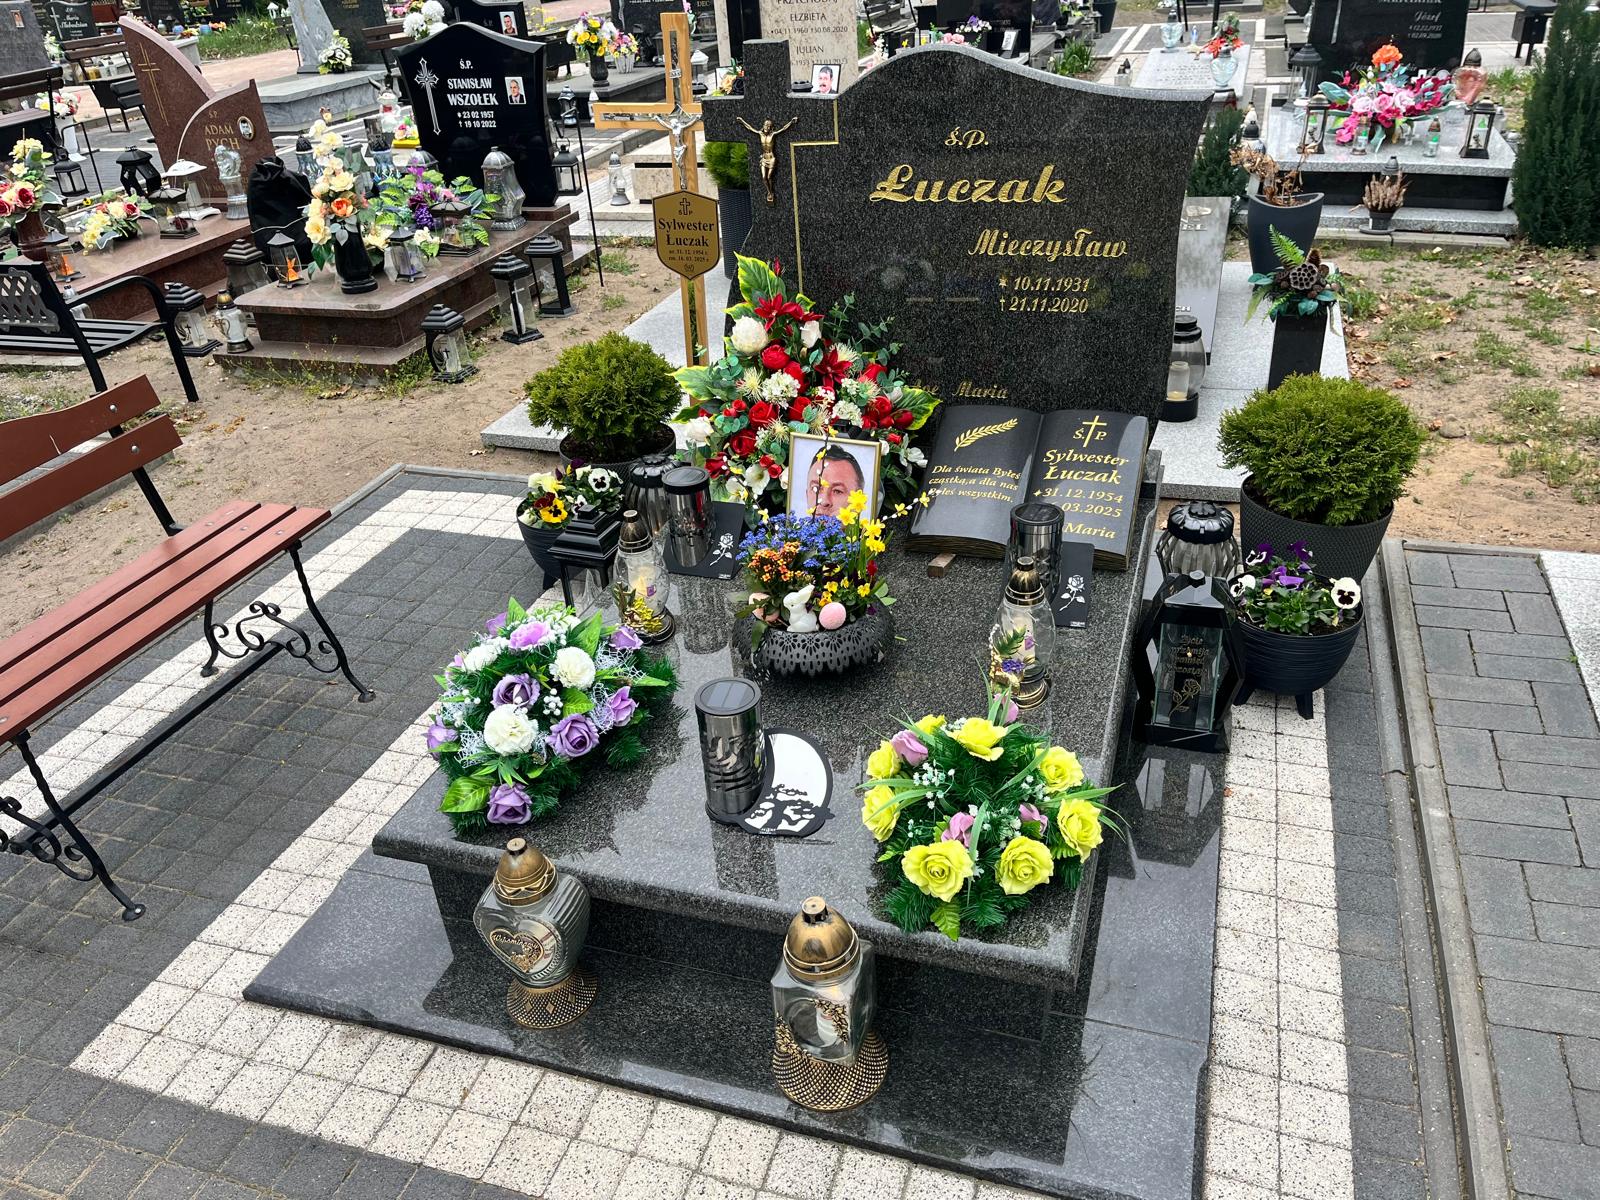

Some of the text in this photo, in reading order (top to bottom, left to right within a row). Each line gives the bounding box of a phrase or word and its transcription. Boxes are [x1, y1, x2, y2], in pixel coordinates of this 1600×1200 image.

[447, 78, 492, 89] STANISŁAW
[447, 93, 499, 106] WSZOŁEK
[204, 125, 234, 135] ADAM
[870, 164, 1068, 203] Łuczak
[659, 218, 714, 233] Sylwester
[968, 227, 1128, 262] Mieczysław
[1013, 277, 1089, 292] 10.11.1931
[1009, 297, 1088, 313] 21.11.2020
[952, 381, 1008, 399] Maria
[1043, 449, 1129, 466] Sylwester
[932, 465, 951, 474] Dla
[954, 466, 989, 474] świata
[1044, 466, 1122, 484] Łuczak
[979, 478, 996, 486] dla
[1000, 482, 1019, 491] nas
[958, 489, 1013, 503] wszystkim.
[1062, 502, 1123, 518] 03.2025
[1064, 522, 1116, 538] Maria
